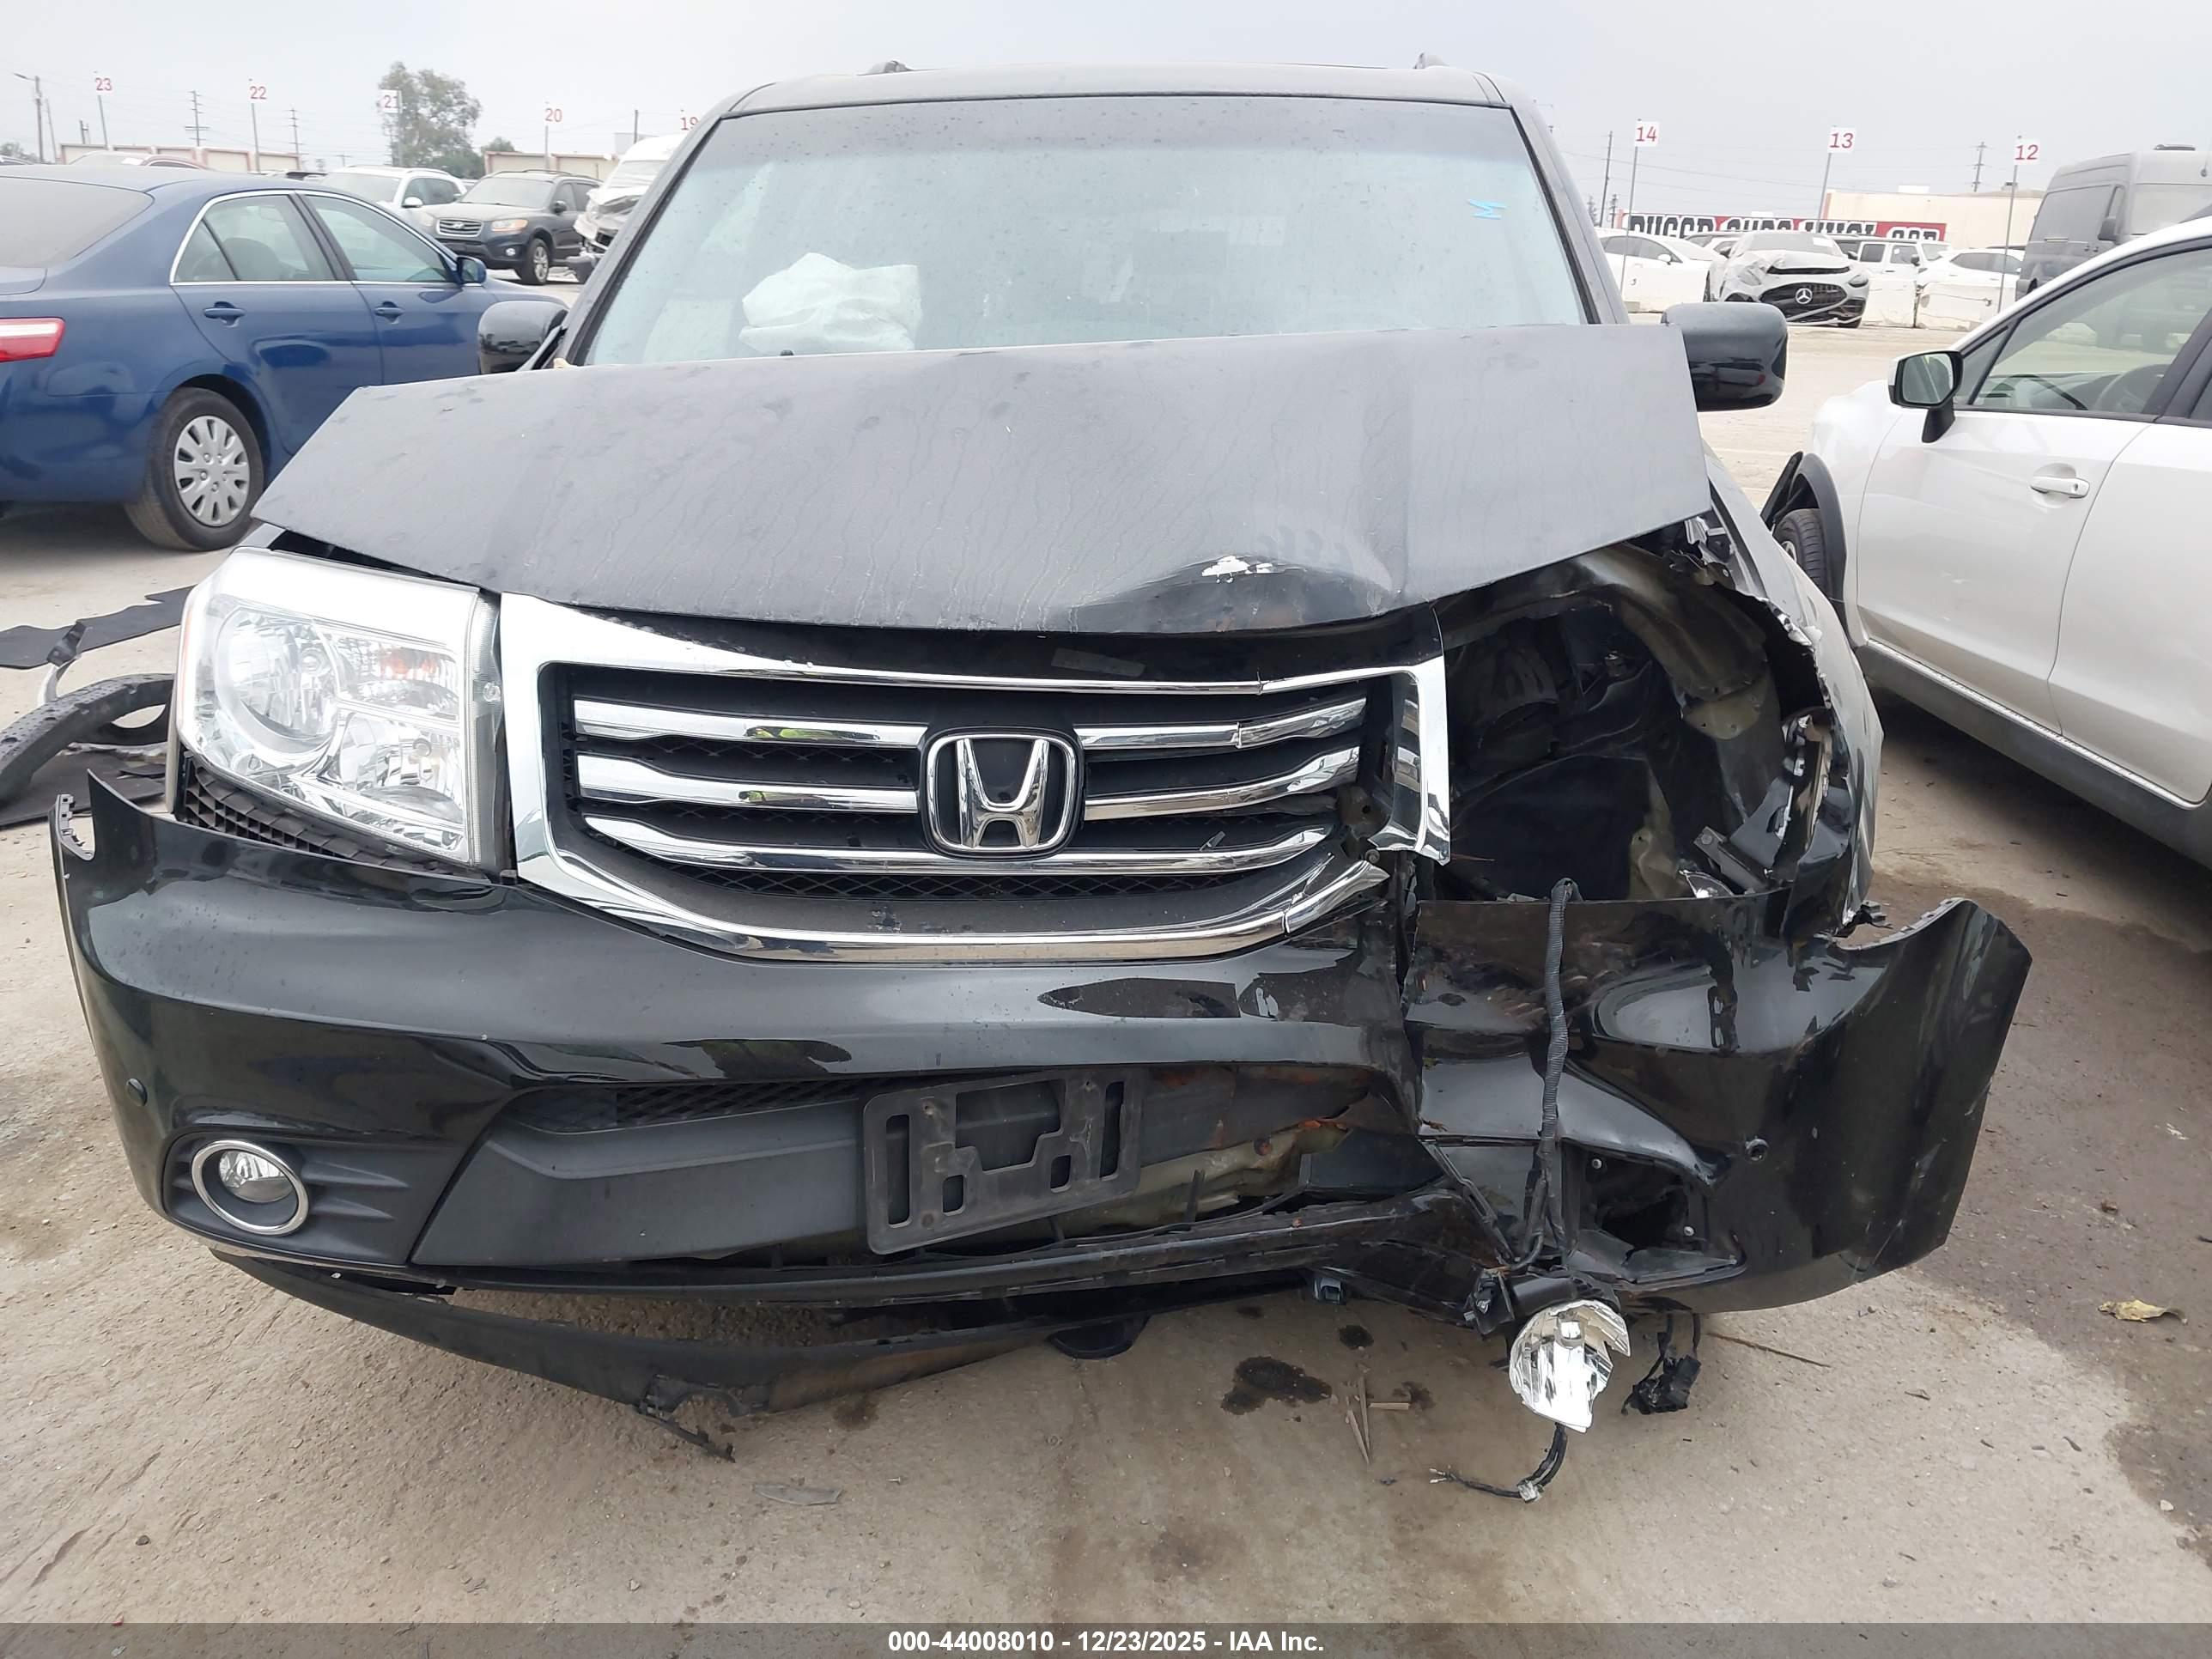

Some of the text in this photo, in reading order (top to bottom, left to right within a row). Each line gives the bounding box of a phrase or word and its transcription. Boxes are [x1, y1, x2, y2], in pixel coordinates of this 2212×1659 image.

[95, 77, 112, 91] 23
[250, 86, 267, 100] 22
[545, 108, 562, 122] 20
[1636, 126, 1657, 143] 14
[1830, 132, 1854, 149] 13
[2014, 144, 2039, 161] 12
